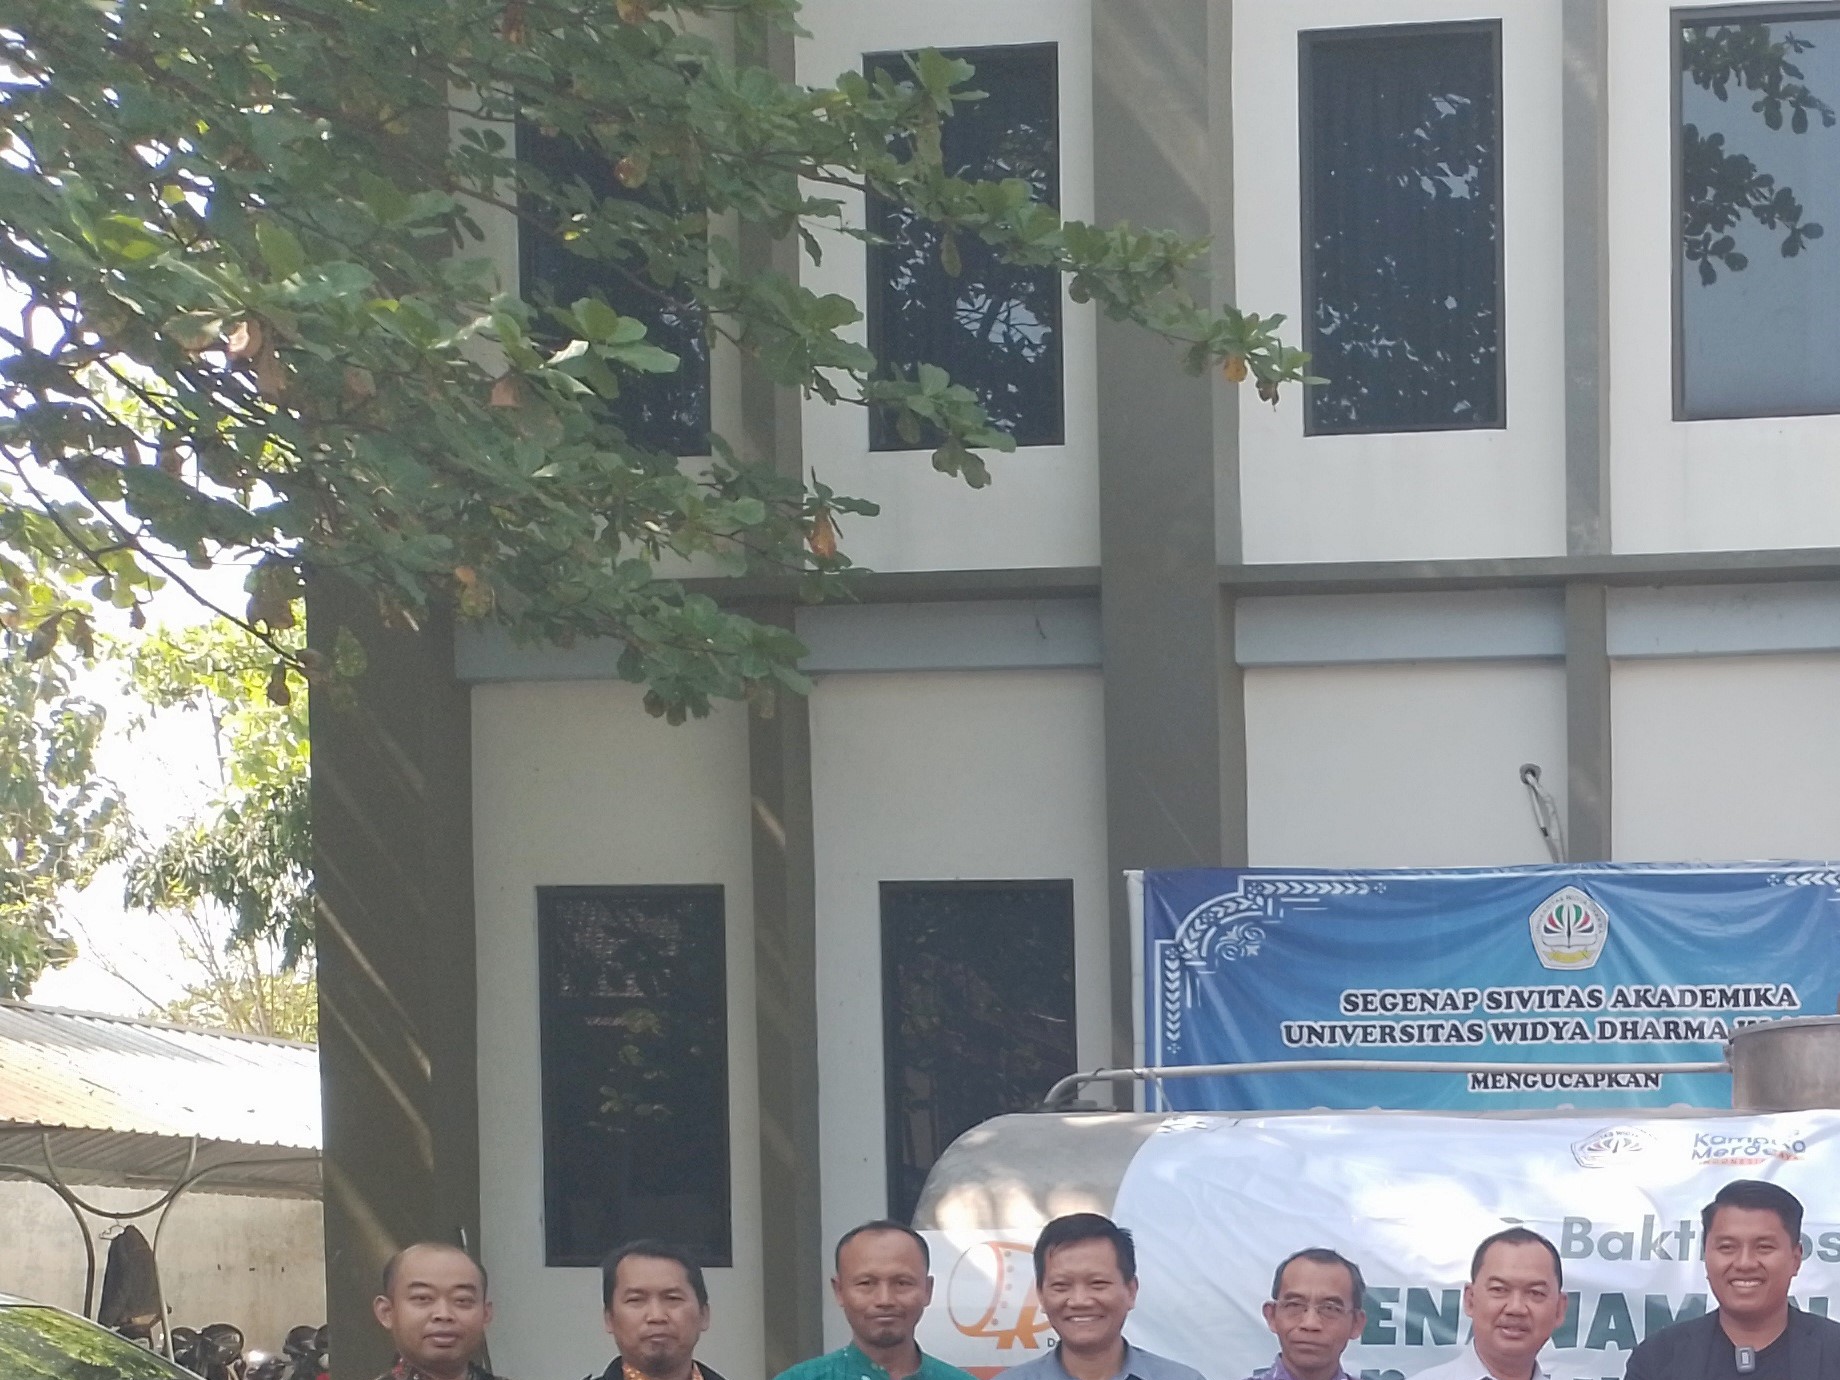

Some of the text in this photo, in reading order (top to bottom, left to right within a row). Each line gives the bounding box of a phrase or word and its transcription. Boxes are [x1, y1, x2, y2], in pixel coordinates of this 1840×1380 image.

[1341, 986, 1800, 1014] SEGENAP SIVITAS AKADEMIKA
[1282, 1020, 1485, 1045] UNIVERSITAS
[1489, 1020, 1591, 1043] WIDYA
[1597, 1019, 1730, 1042] DHARMA
[1467, 1071, 1662, 1090] MENGUCAPKAN
[1560, 1213, 1706, 1262] Bakt
